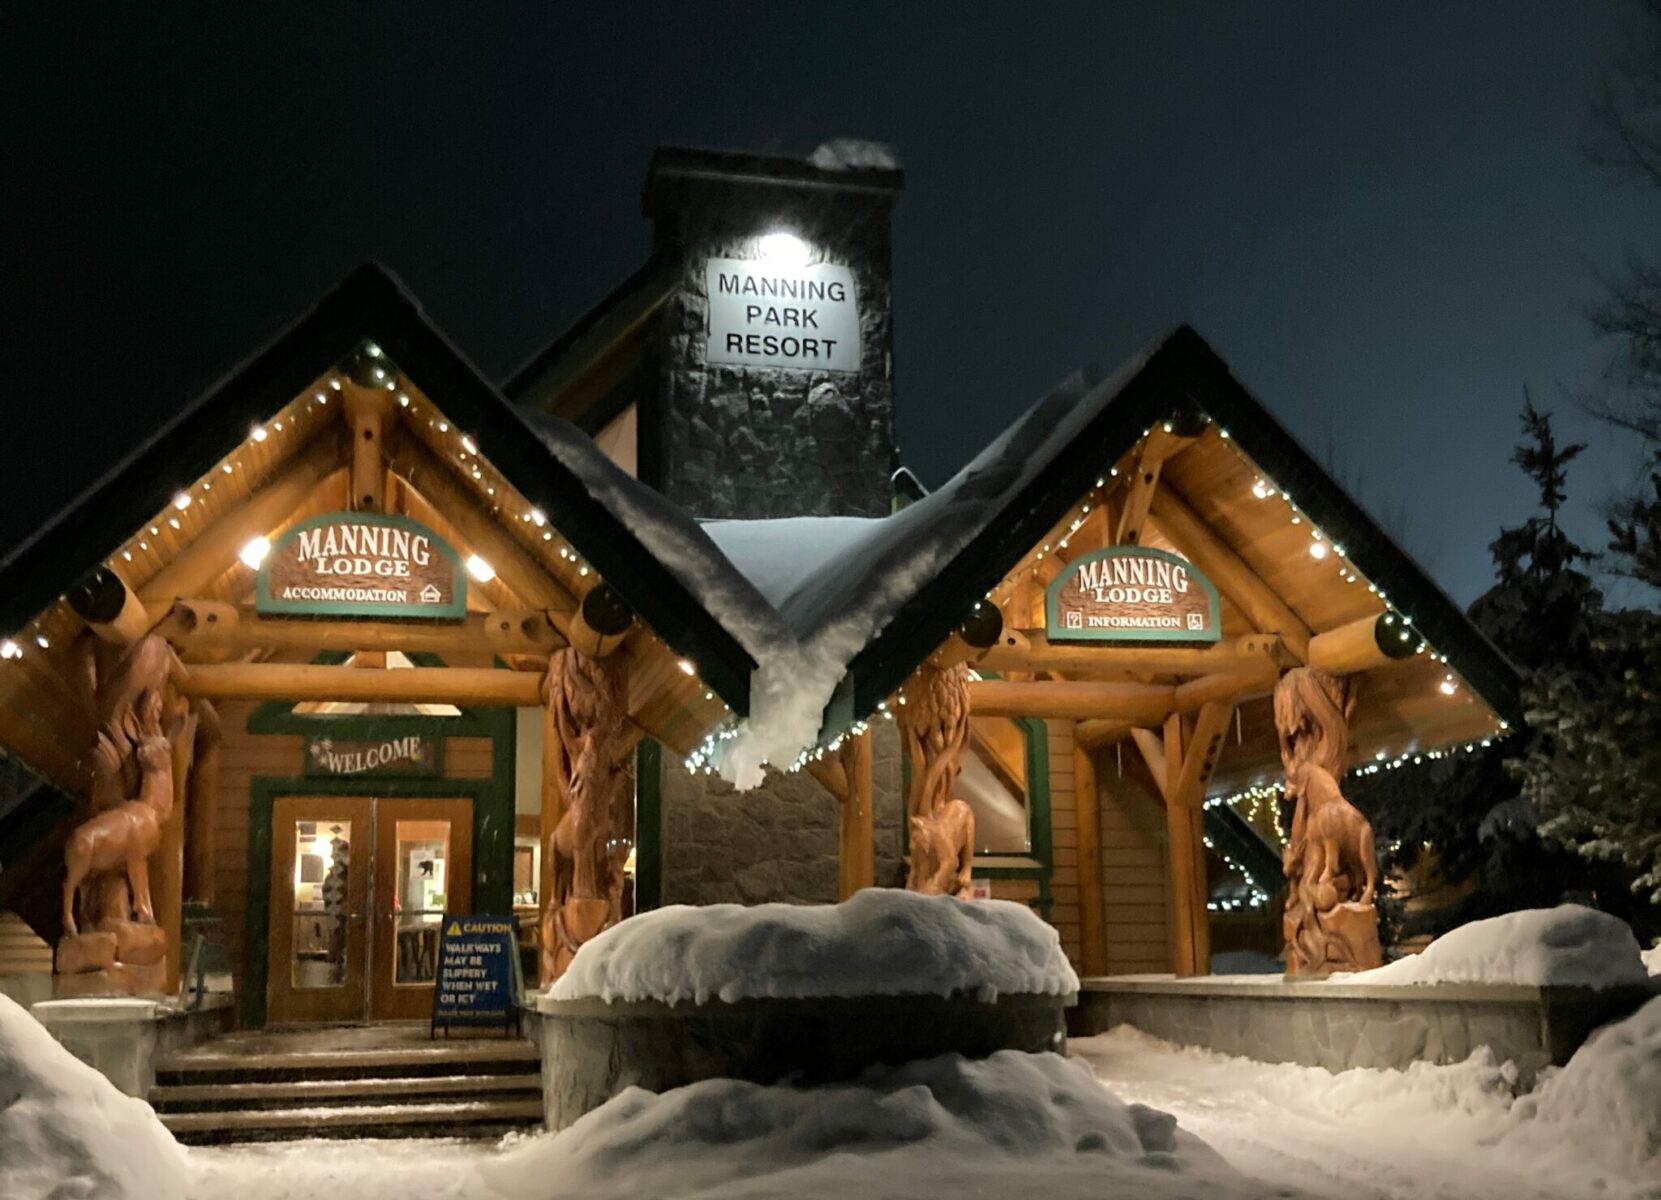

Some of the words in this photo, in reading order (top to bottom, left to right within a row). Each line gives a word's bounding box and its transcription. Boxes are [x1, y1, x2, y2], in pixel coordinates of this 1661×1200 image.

[719, 273, 845, 302] MANNING
[746, 305, 819, 328] PARK
[726, 333, 838, 359] RESORT
[297, 525, 431, 566] MANNING
[316, 557, 411, 577] LODGE
[1078, 557, 1189, 593] MANNING
[282, 587, 408, 604] ACCOMMODATION
[1094, 588, 1173, 604] LODGE
[1088, 616, 1181, 627] INFORMATION
[326, 736, 420, 773] WELCOME
[463, 923, 512, 933] CAUTION
[446, 943, 502, 953] WALKWAYS
[444, 956, 466, 966] MAY
[469, 956, 482, 966] BE
[443, 968, 487, 978] SLIPPERY
[442, 981, 473, 991] WHEN
[476, 981, 498, 991] WET
[440, 994, 455, 1003] OR
[458, 994, 475, 1003] ICY
